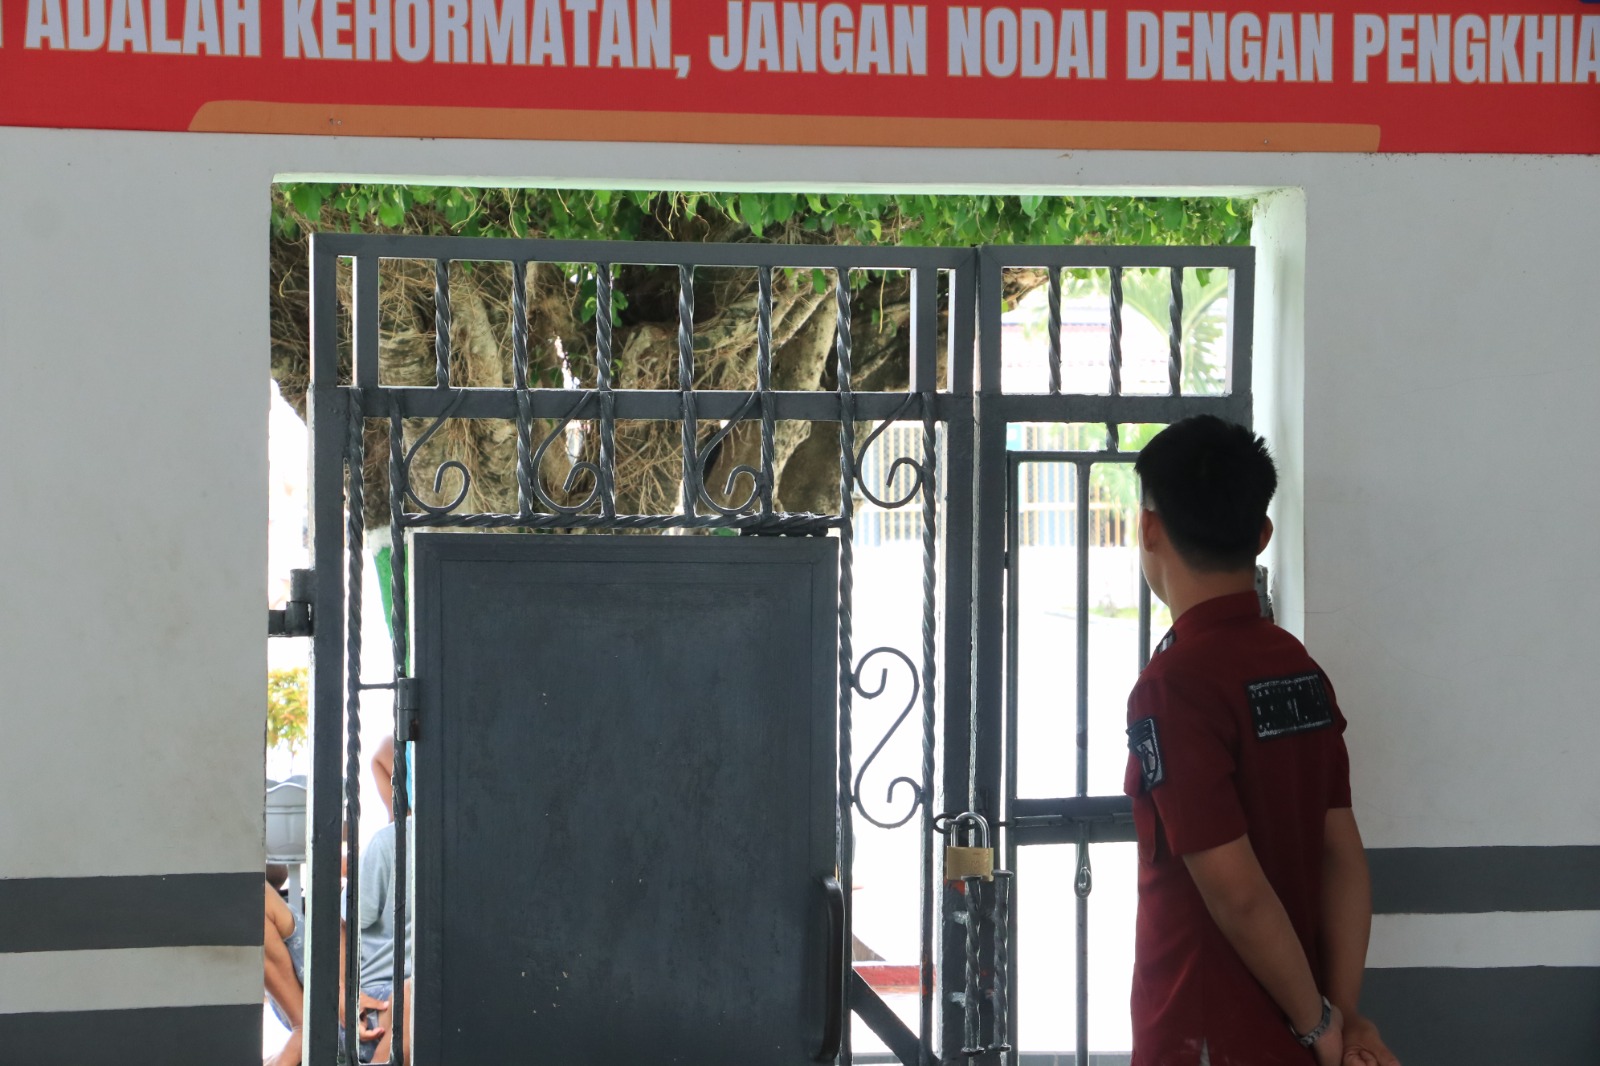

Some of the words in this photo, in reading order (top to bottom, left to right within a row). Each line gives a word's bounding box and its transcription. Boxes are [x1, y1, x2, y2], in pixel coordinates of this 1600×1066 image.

[25, 0, 261, 57] ADALAH
[283, 0, 691, 78] KEHORMATAN,
[709, 0, 927, 76] JANGAN
[948, 7, 1107, 79] NODAI
[1127, 11, 1334, 83] DENGAN
[1353, 14, 1600, 84] PENGKHIA
